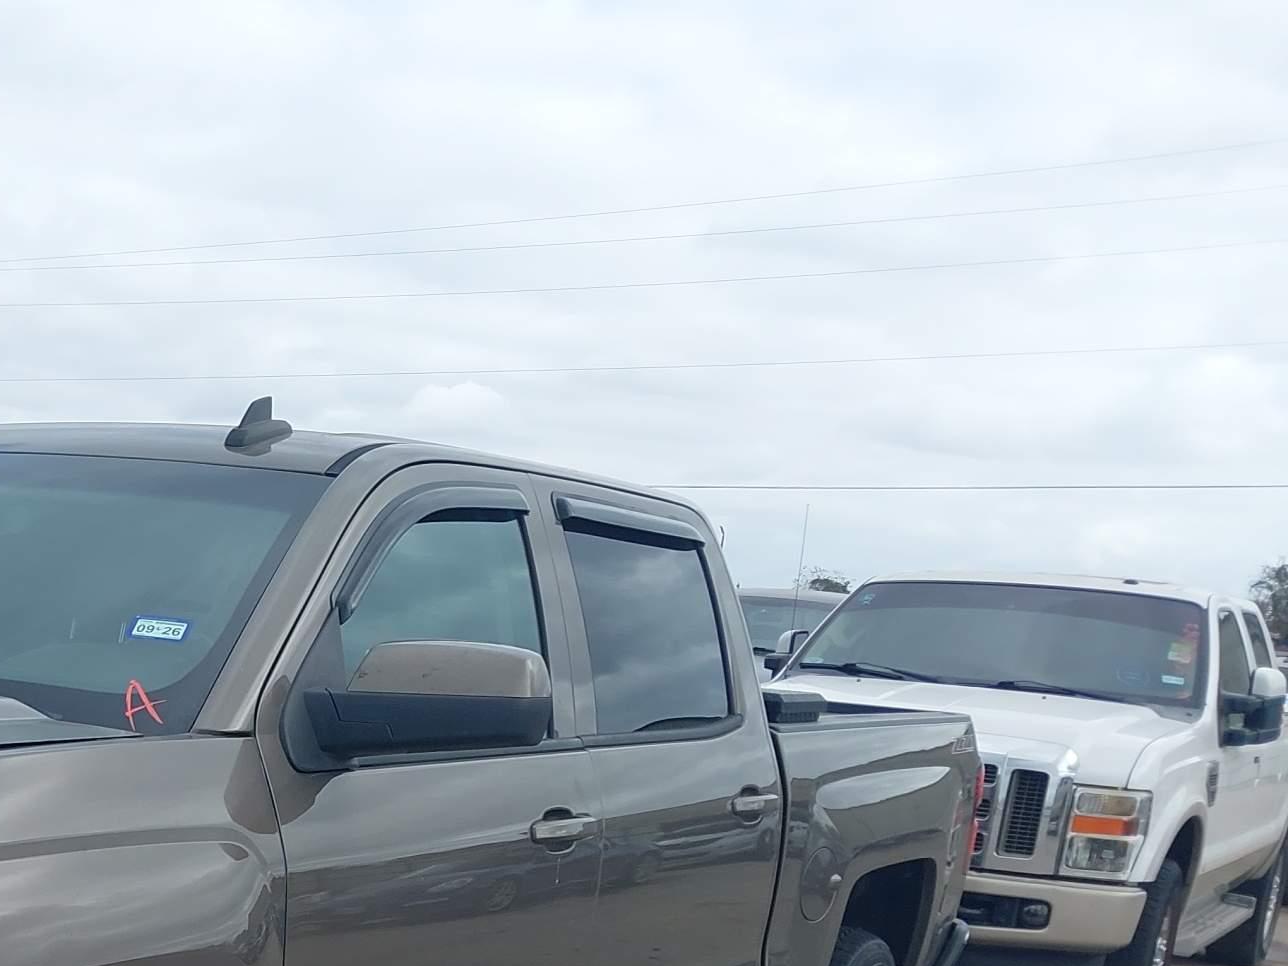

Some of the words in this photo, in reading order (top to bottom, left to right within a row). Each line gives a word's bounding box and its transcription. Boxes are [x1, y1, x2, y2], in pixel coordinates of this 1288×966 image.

[136, 623, 155, 634] 09
[161, 626, 182, 637] 26
[124, 679, 168, 732] A
